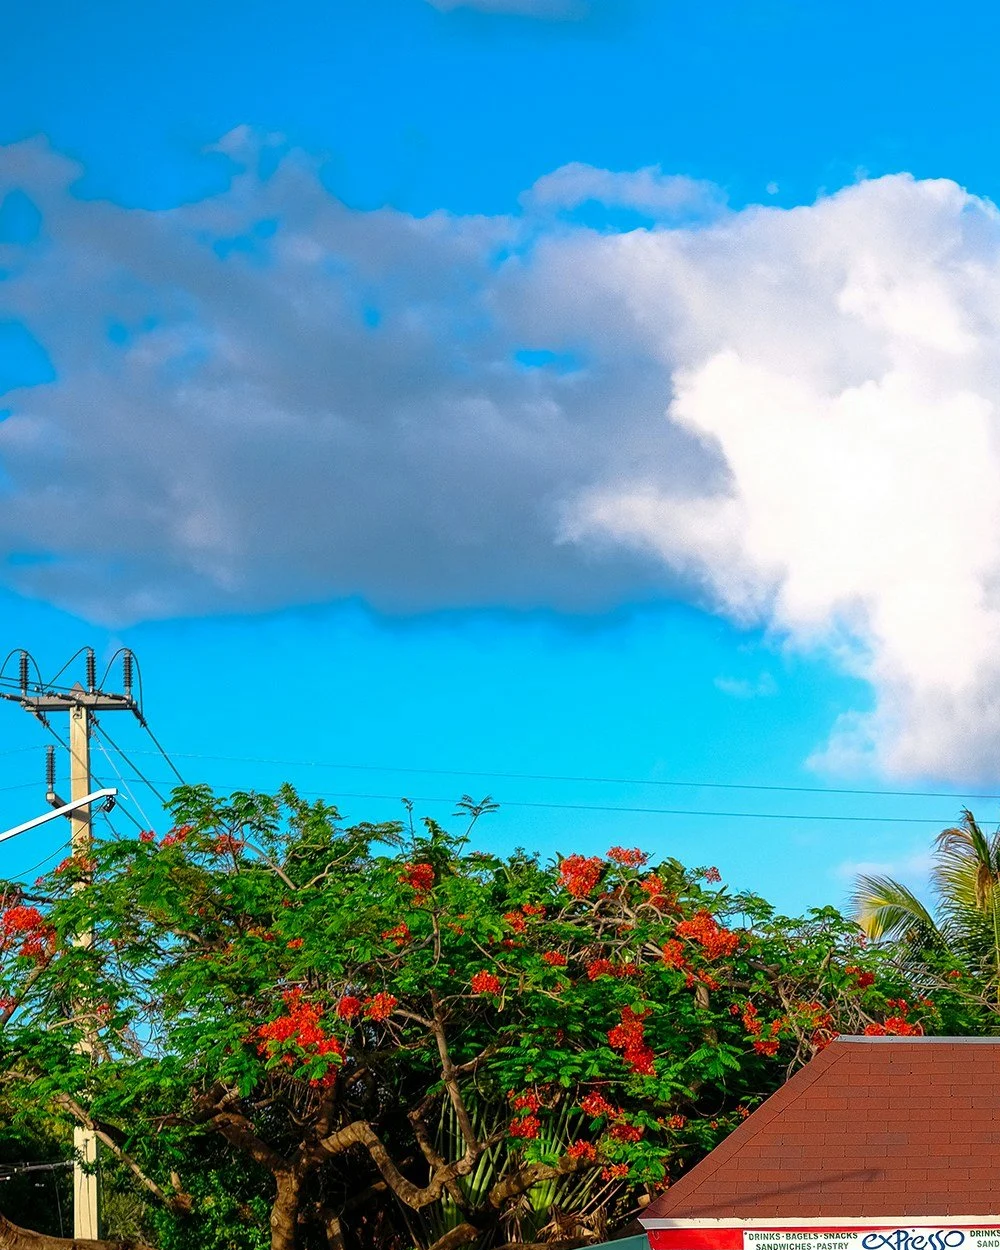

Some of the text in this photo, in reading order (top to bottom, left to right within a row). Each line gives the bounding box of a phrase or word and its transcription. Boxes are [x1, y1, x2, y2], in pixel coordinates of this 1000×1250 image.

[748, 1232, 858, 1241] DRINKS BAGELS SNACKS
[755, 1242, 849, 1250] SANDWICHES PASTRY
